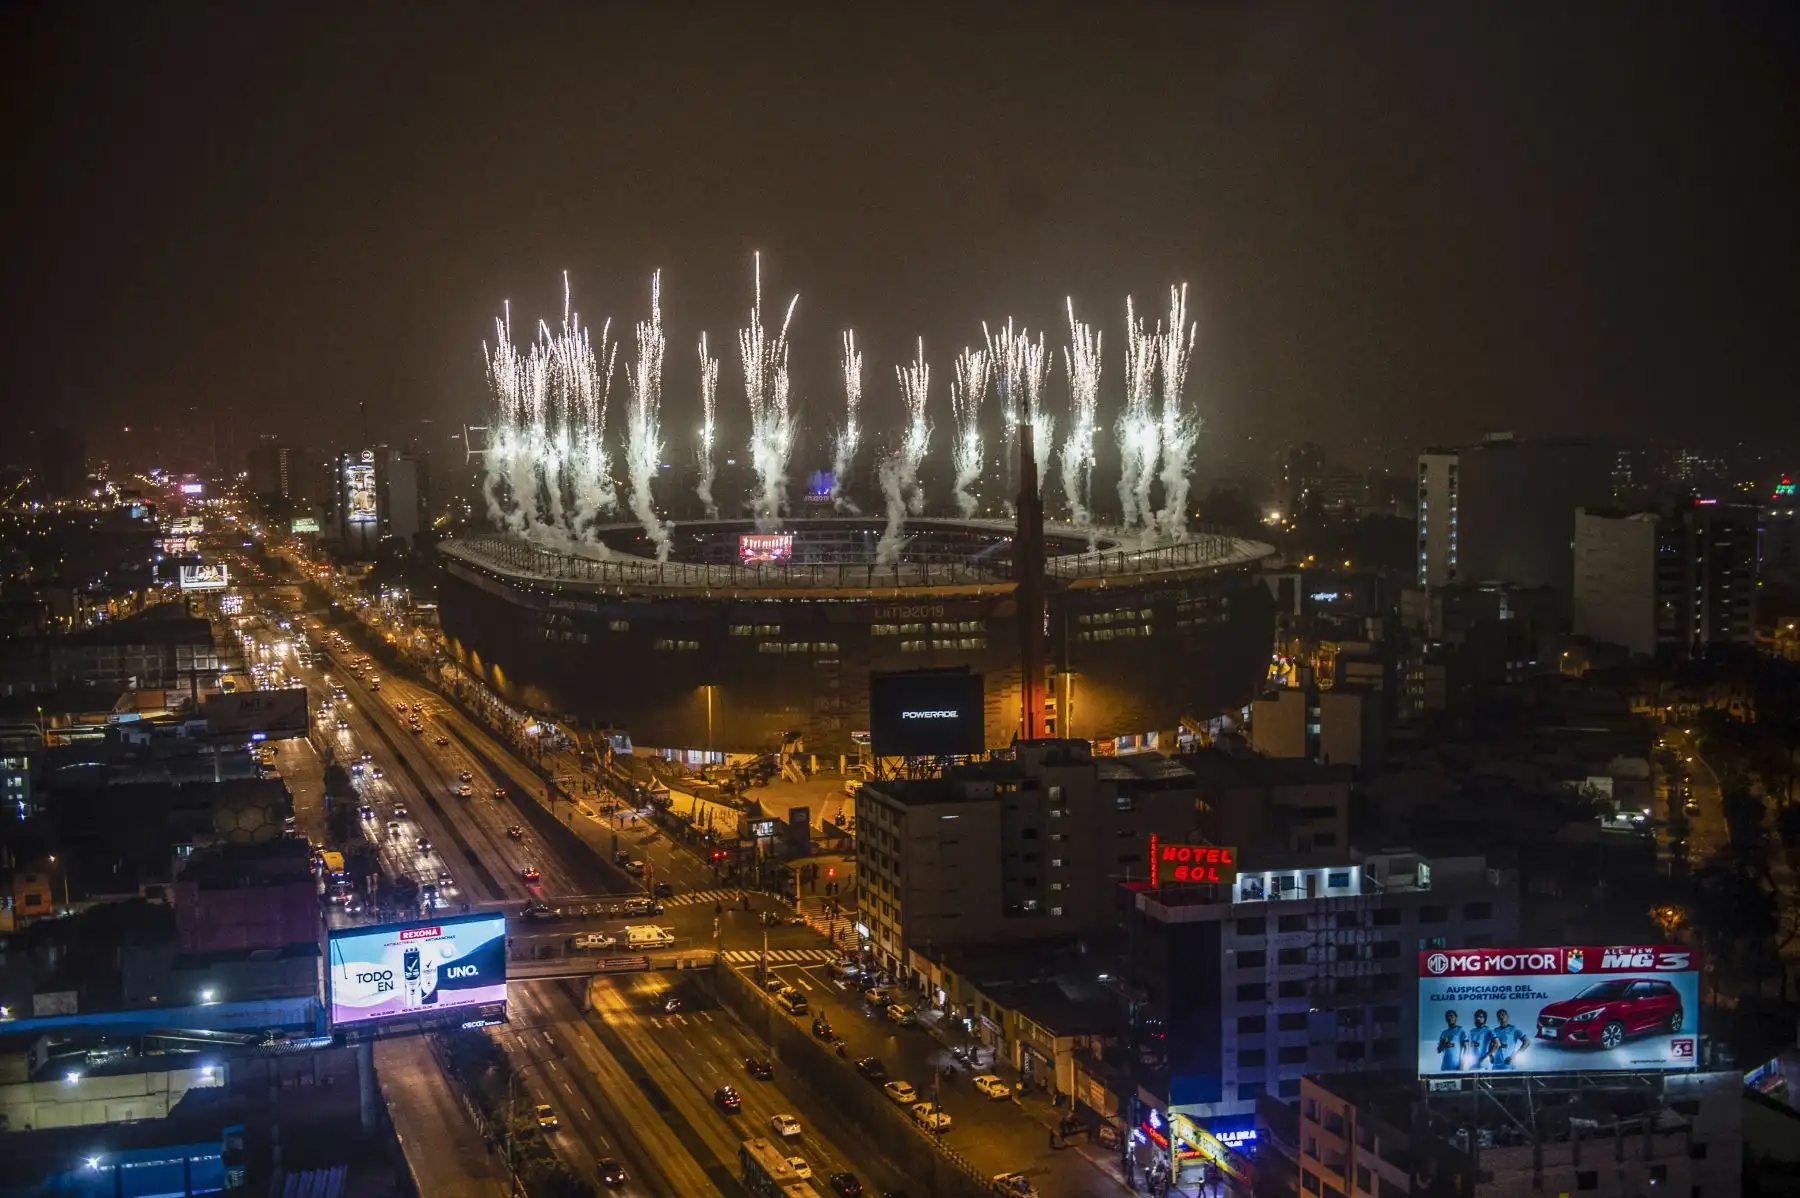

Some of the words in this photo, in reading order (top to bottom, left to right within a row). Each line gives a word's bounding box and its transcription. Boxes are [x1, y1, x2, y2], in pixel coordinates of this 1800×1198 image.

[902, 711, 958, 719] POWERADE
[1163, 847, 1232, 864] HOTEL
[1174, 866, 1219, 882] GOL
[402, 929, 438, 939] REXONA
[1451, 955, 1480, 972] MG
[1485, 954, 1557, 972] MOTOR
[356, 970, 393, 984] TODO
[447, 965, 479, 979] UNO.
[377, 981, 393, 992] EN
[1446, 985, 1513, 993] AUSPICIADOR
[1515, 984, 1532, 992] DEL
[1458, 993, 1507, 1001] SPORTING
[1509, 992, 1548, 1000] CRISTAL
